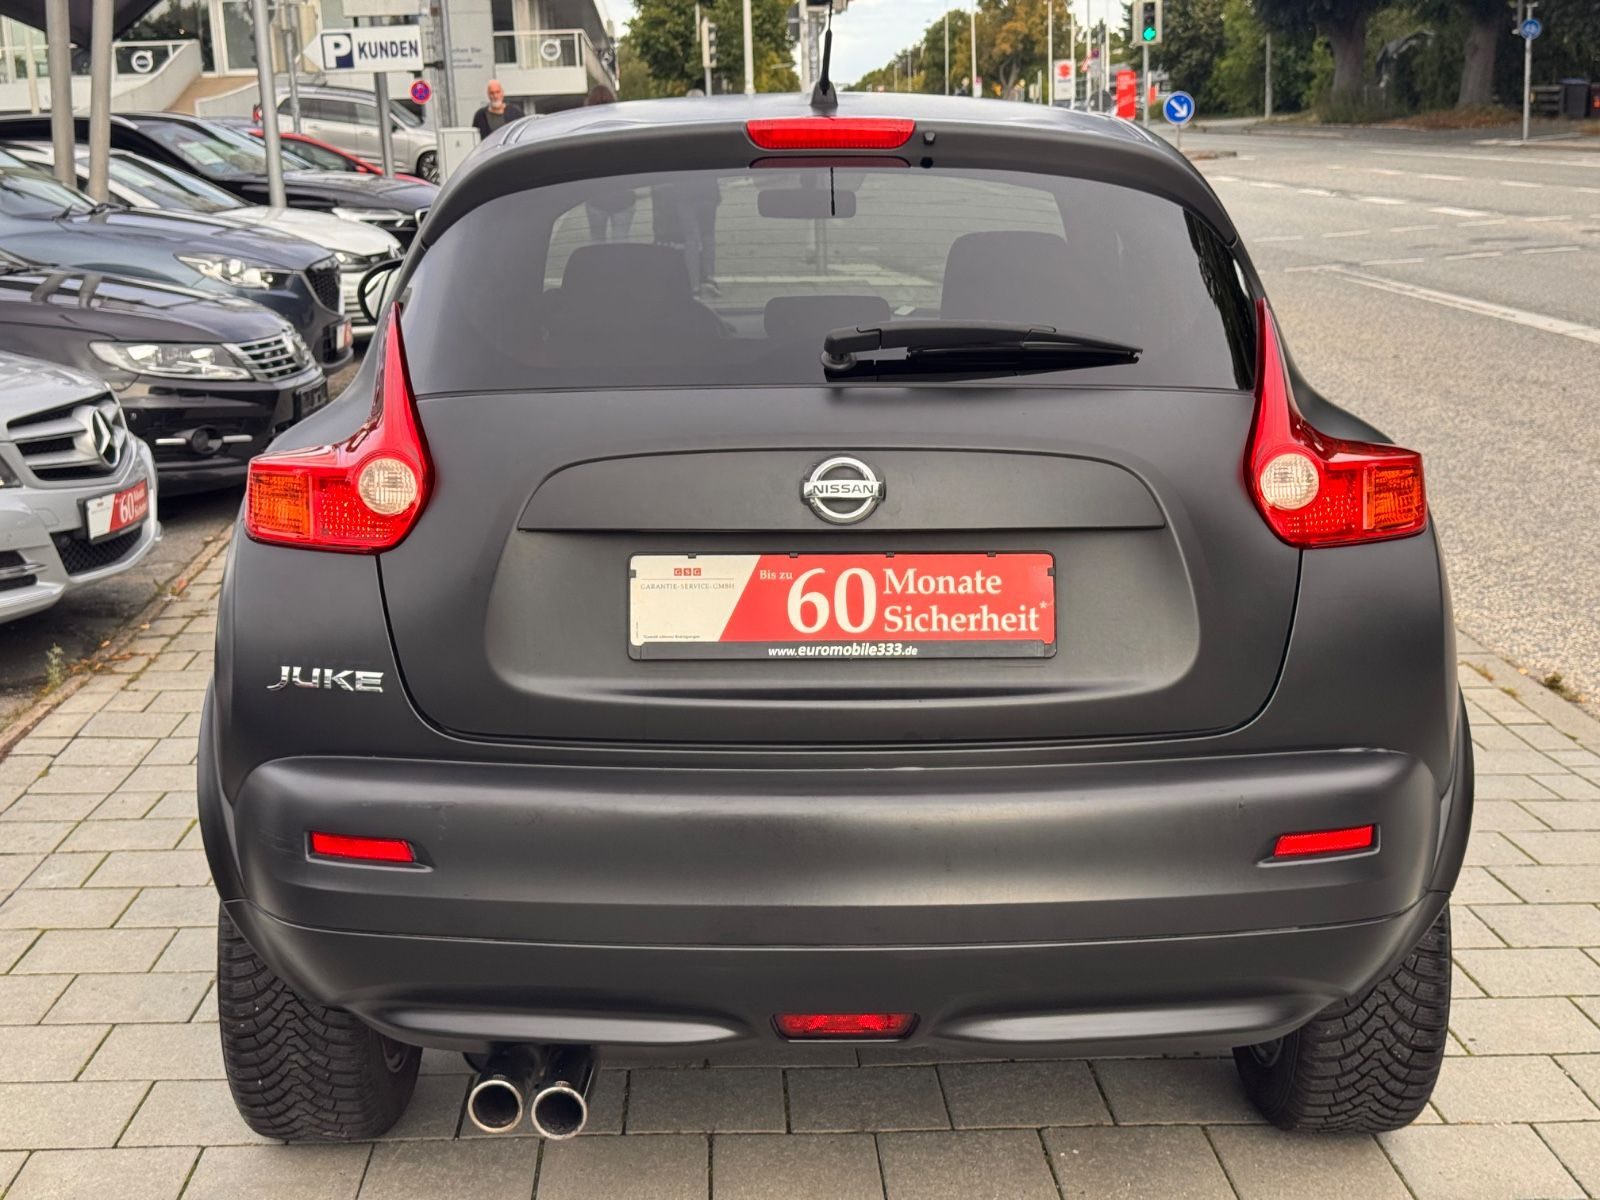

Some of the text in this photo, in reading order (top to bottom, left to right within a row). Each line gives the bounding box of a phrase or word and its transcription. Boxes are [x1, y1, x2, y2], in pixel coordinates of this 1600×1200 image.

[358, 40, 418, 59] KUNDEN
[812, 484, 874, 494] NISSAN
[120, 492, 134, 524] 60
[883, 568, 1002, 594] Monate
[760, 567, 877, 634] Bis zu 60
[768, 642, 918, 656] www.euromobile333.de
[266, 666, 384, 693] JUKE
